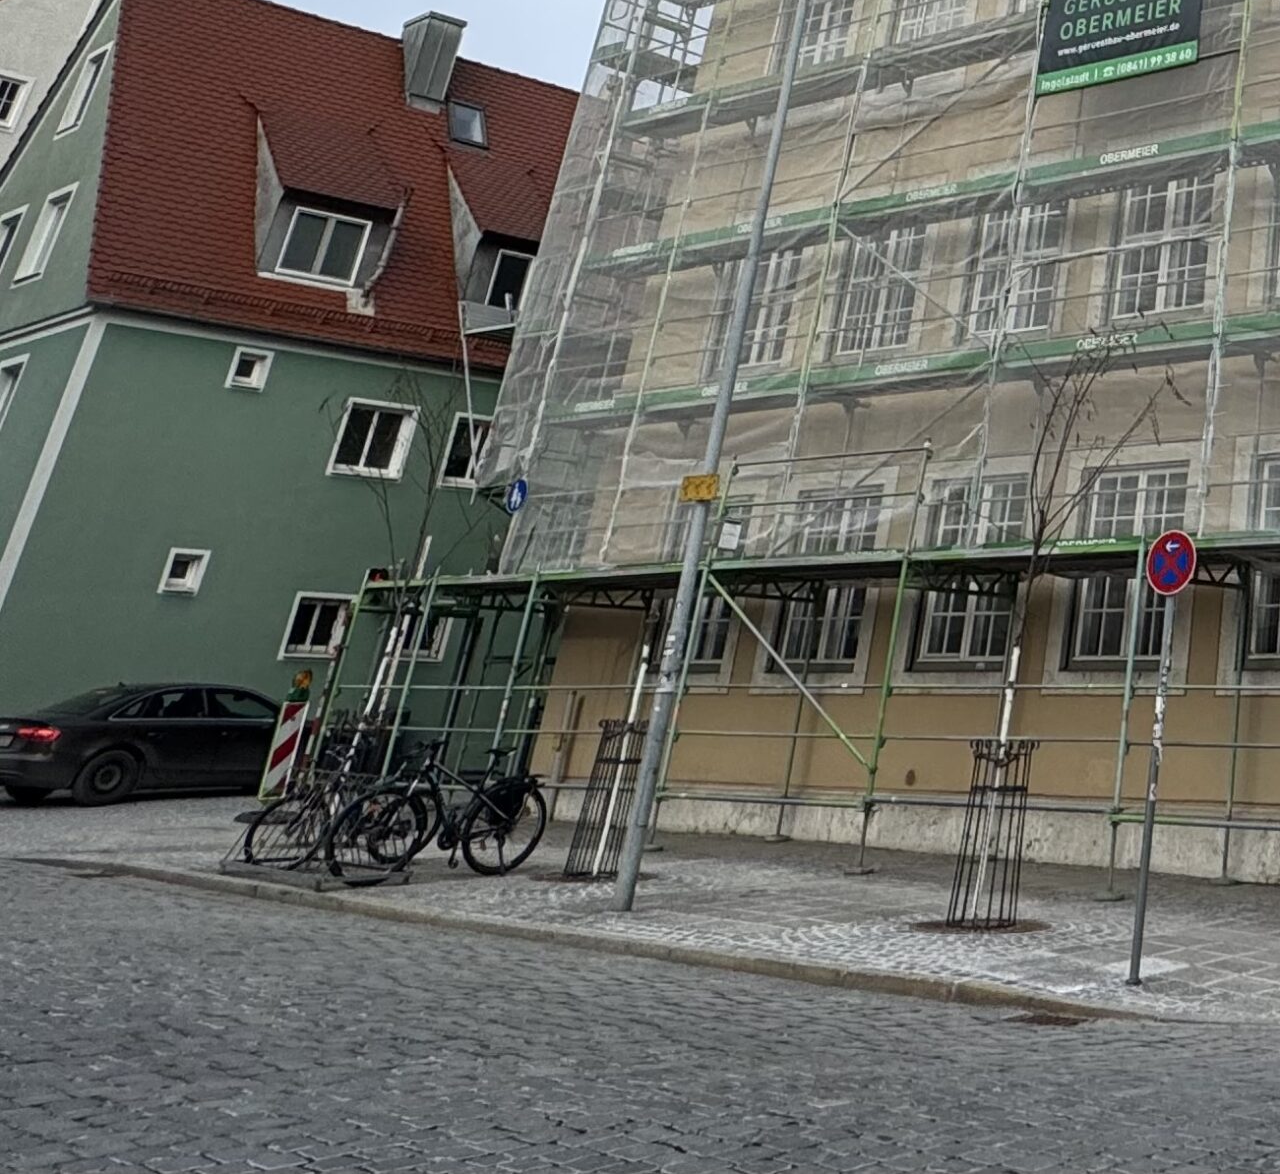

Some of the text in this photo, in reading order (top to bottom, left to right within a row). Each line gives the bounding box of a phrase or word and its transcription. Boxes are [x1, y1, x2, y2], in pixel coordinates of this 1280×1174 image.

[1041, 48, 1192, 91] Ingolstadt (0841) 99 38 60
[1100, 143, 1159, 166] OBERMEIER
